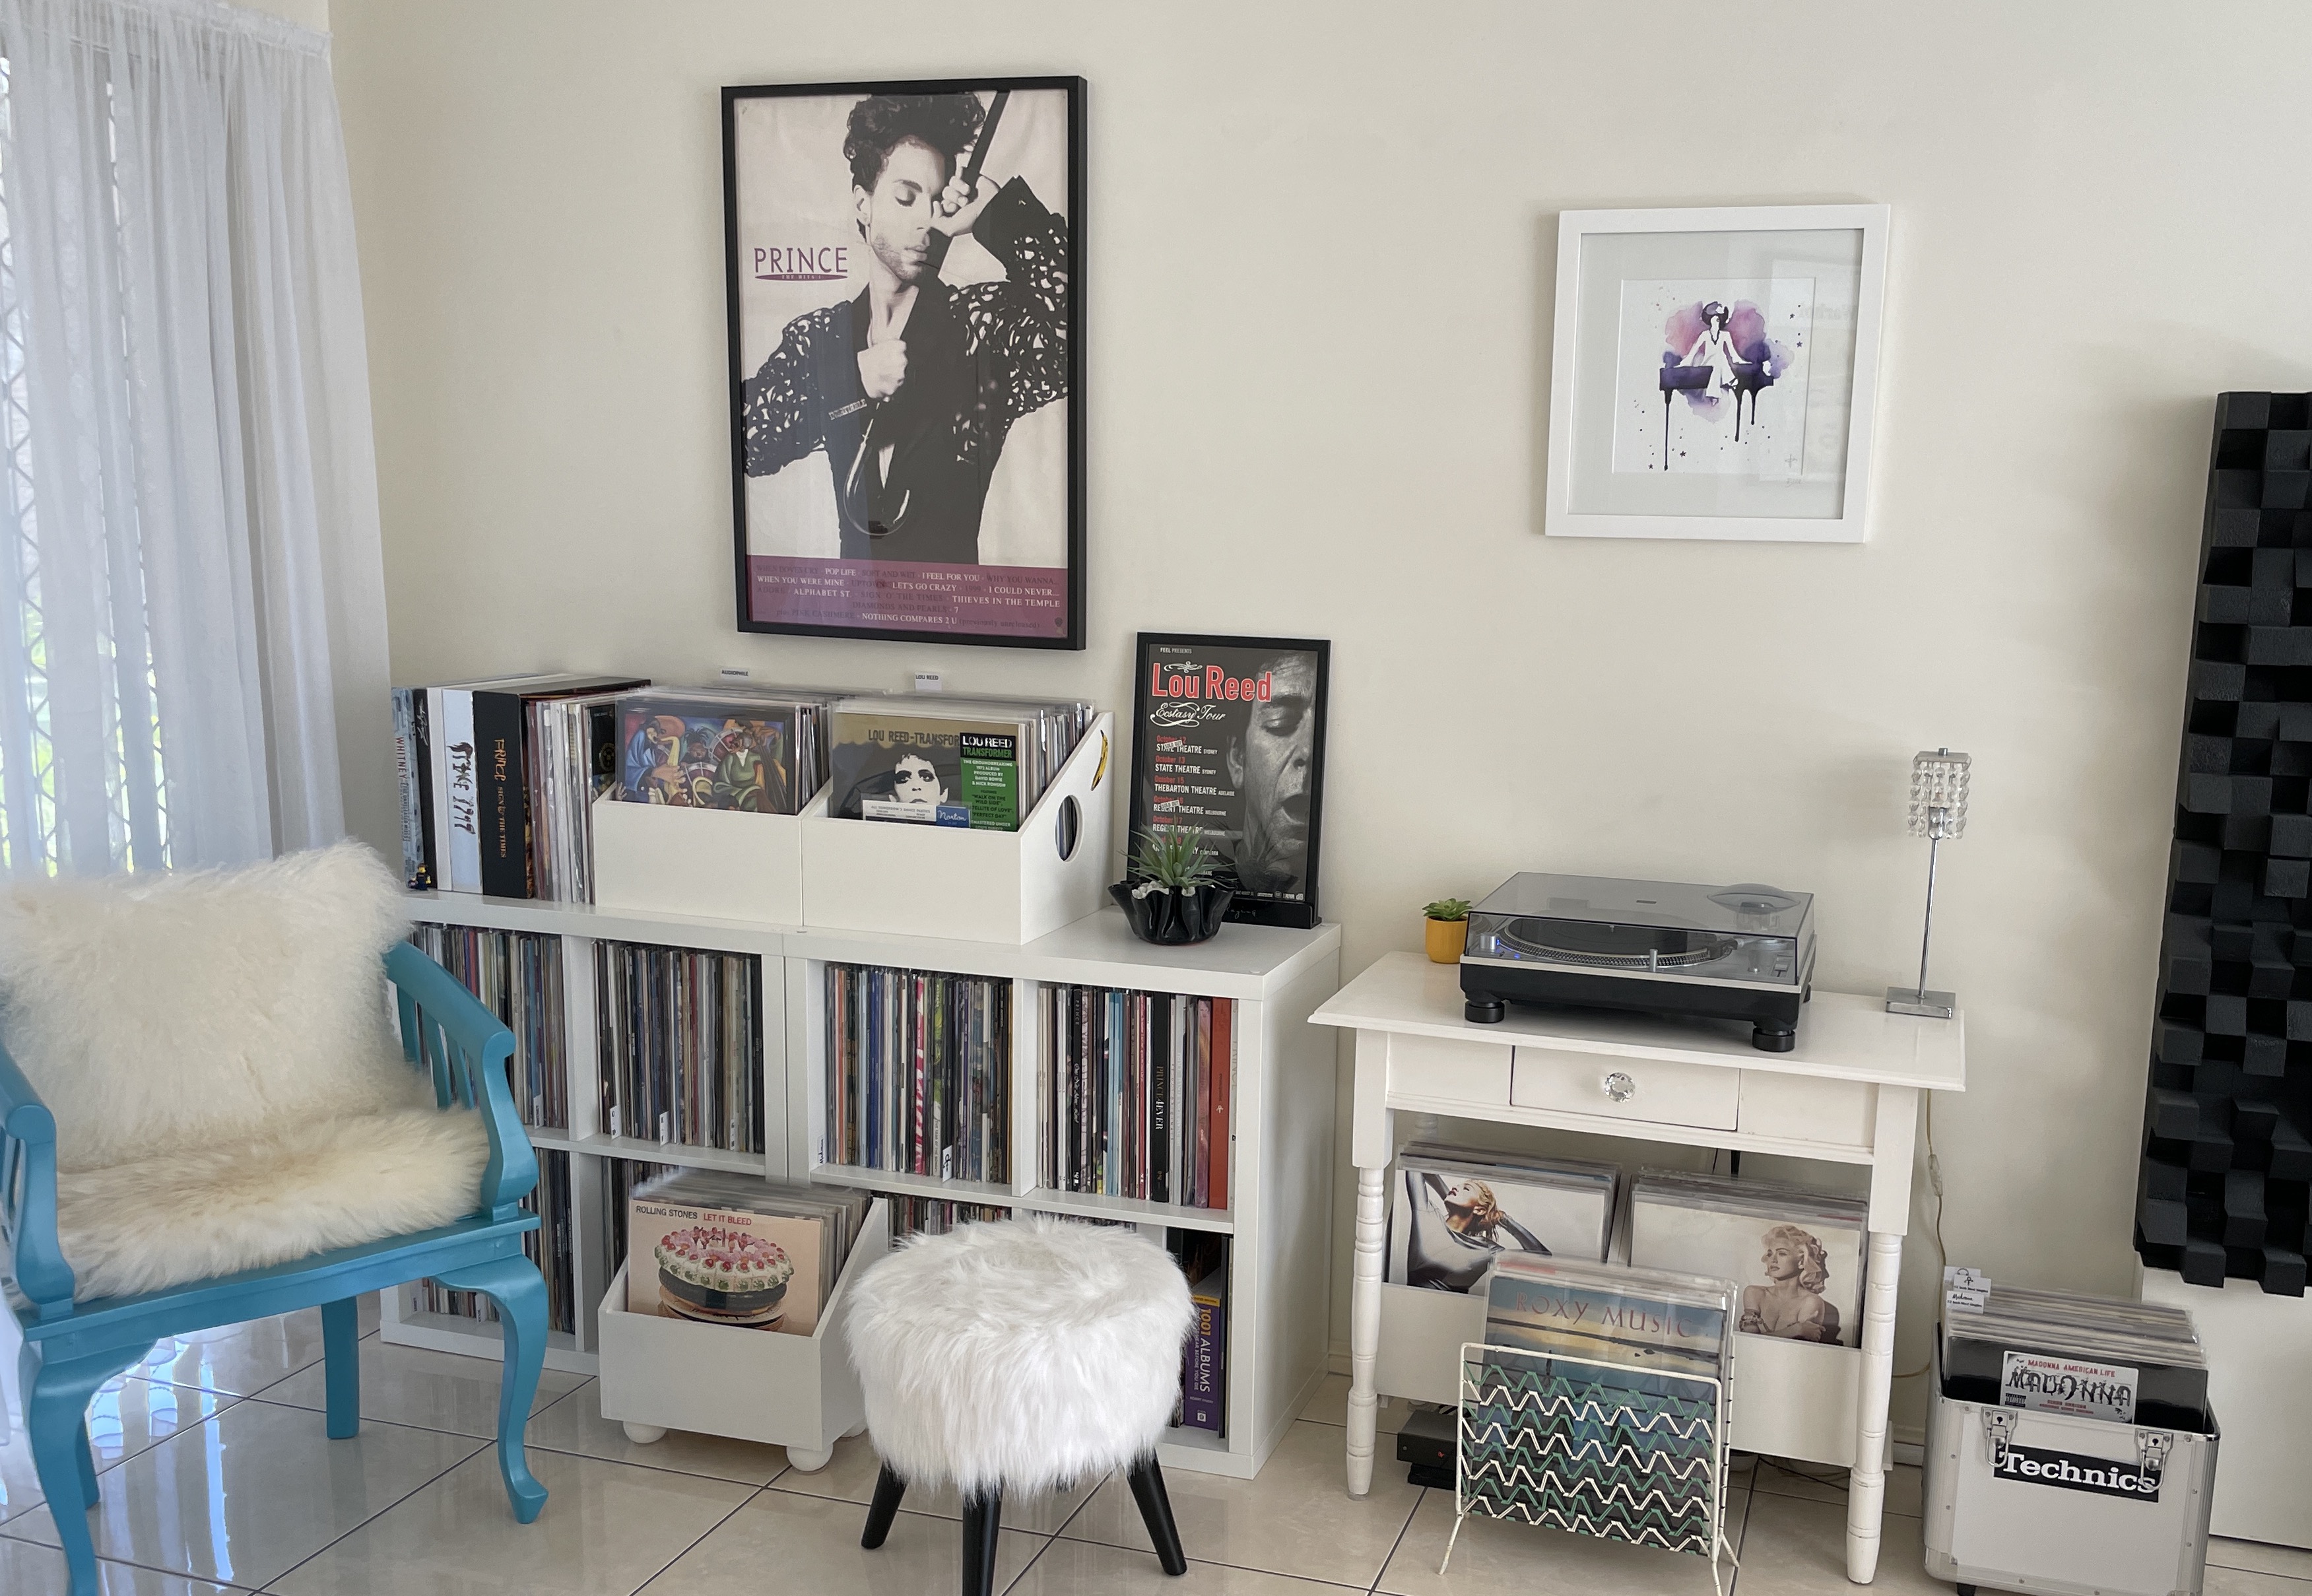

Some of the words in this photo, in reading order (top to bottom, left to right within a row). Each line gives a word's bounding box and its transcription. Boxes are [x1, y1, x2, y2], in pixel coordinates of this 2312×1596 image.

[754, 247, 848, 273] PRINCE
[793, 588, 838, 597] ALPHABET
[952, 595, 989, 604] THIEVES
[1024, 599, 1061, 607] TEMPLE
[853, 601, 895, 611] DIAMONDS
[862, 613, 898, 622] NOTHING
[900, 615, 943, 624] COMPARES
[1152, 663, 1200, 699] Lou
[1205, 665, 1272, 702] Reed
[1152, 702, 1199, 725] Ecstasy
[1197, 704, 1226, 721] Tour
[869, 729, 884, 741] LOU
[962, 735, 983, 747] LOU
[985, 737, 1012, 748] REED
[396, 737, 408, 780] WHITNEY
[962, 747, 1012, 758] TRANSFORMER
[1176, 745, 1202, 754] THEATRE
[1155, 763, 1173, 772] STATE
[1175, 764, 1201, 774] THEATRE
[1154, 783, 1189, 793] THEBARTON
[1191, 785, 1217, 795] THEATRE
[938, 810, 968, 821] Norton
[1178, 805, 1204, 815] THEATRE
[636, 1205, 667, 1216] ROLLING
[669, 1209, 698, 1220] STONES
[704, 1213, 717, 1222] LET
[727, 1216, 752, 1226] BLEED
[1200, 1308, 1212, 1336] 1001
[1516, 1292, 1589, 1325] ROXY
[1601, 1306, 1693, 1339] MUSIC
[1200, 1337, 1210, 1393] ALBUMS
[2028, 1359, 2060, 1370] MADONNA
[2063, 1364, 2098, 1376] AMERICAN
[2099, 1368, 2115, 1378] LIFE
[2005, 1366, 2132, 1407] MADONNA
[1998, 1451, 2156, 1494] Technics
